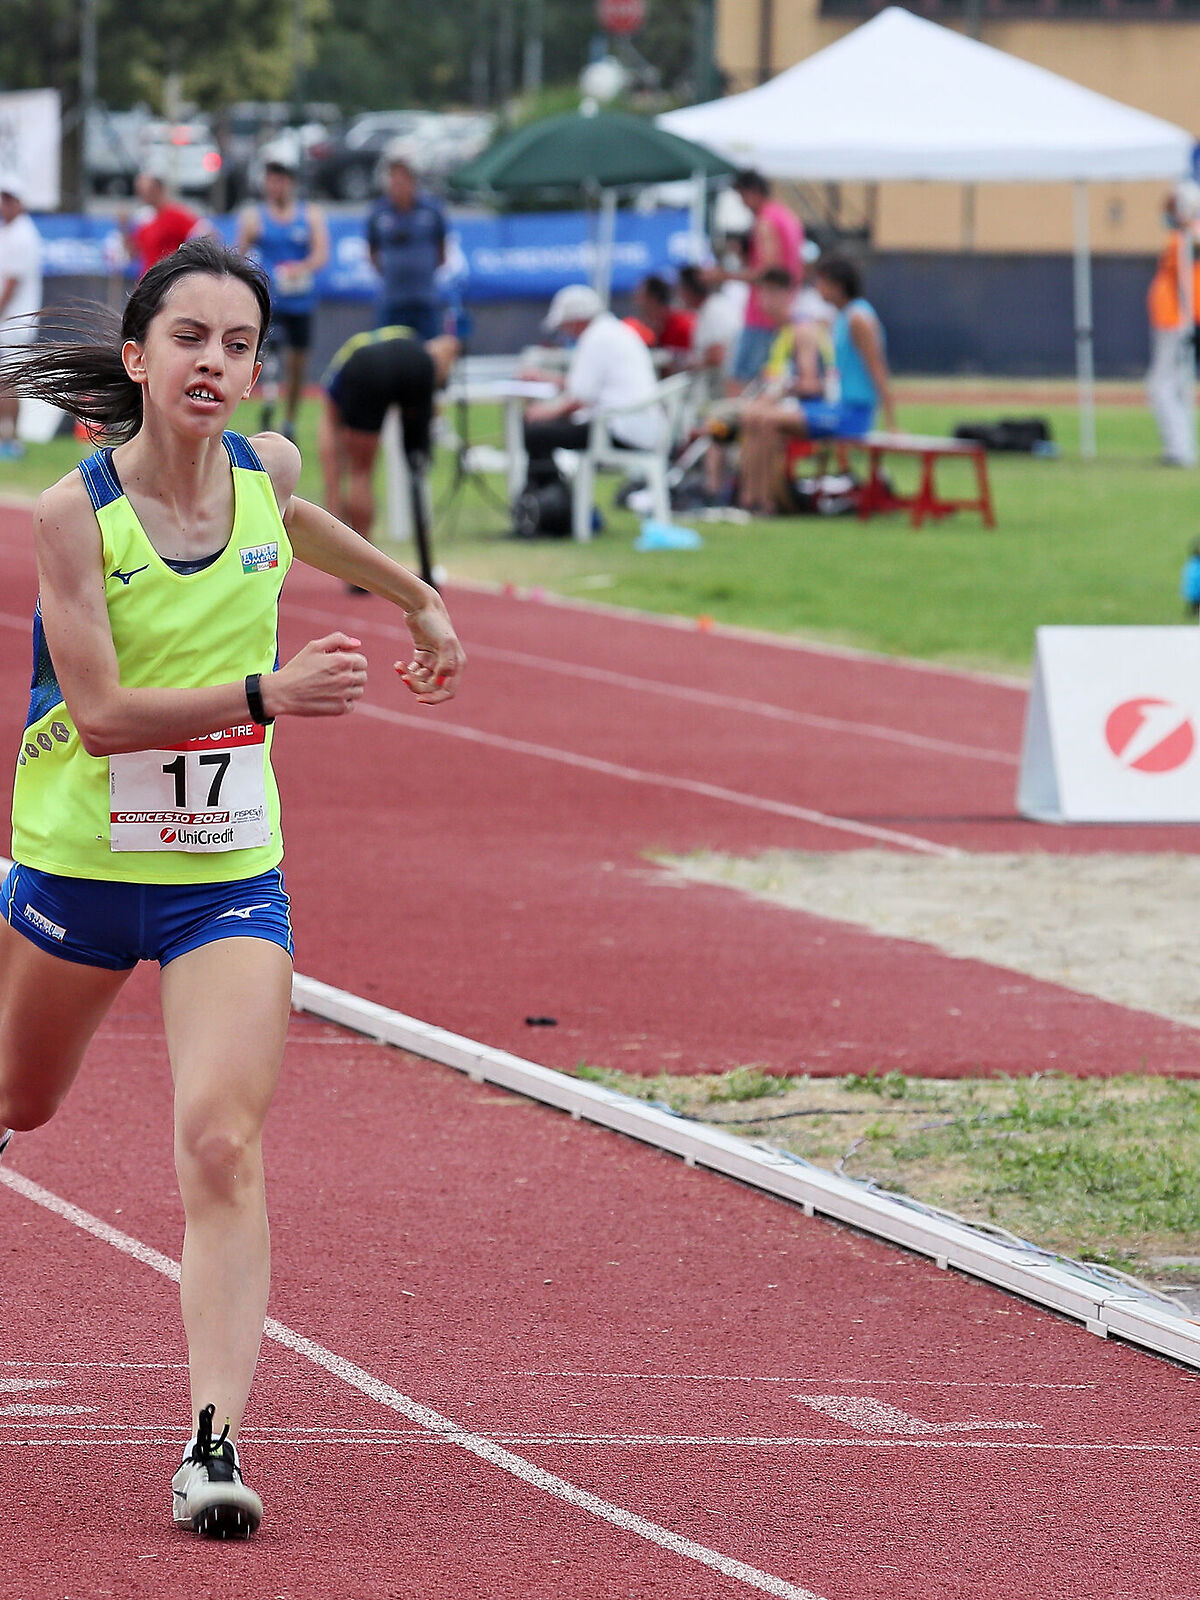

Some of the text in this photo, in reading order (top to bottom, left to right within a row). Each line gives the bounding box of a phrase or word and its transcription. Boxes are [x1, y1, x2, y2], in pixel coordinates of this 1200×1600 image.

[242, 553, 277, 566] OMERO
[190, 723, 255, 742] OLTRE
[161, 752, 232, 809] 17
[116, 812, 190, 824] CONCESIO
[193, 812, 229, 824] 2021
[178, 827, 235, 845] UniCredit
